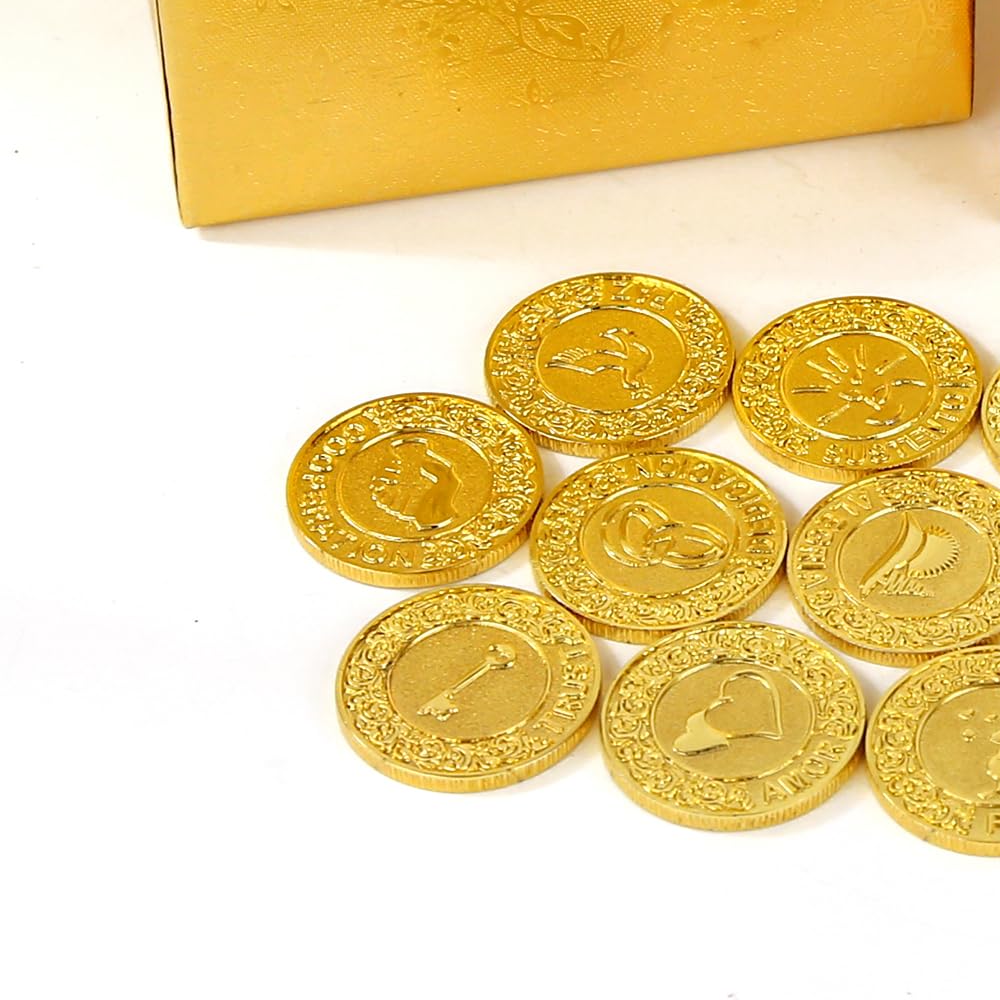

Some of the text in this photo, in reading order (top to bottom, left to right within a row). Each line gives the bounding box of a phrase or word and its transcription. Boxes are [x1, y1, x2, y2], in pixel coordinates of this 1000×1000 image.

[822, 392, 965, 466] SUSTENTO
[299, 422, 413, 569] COOPERATION
[798, 490, 874, 590] ALEGRIA
[533, 649, 588, 734] TRUST
[763, 741, 847, 805] AMOR
